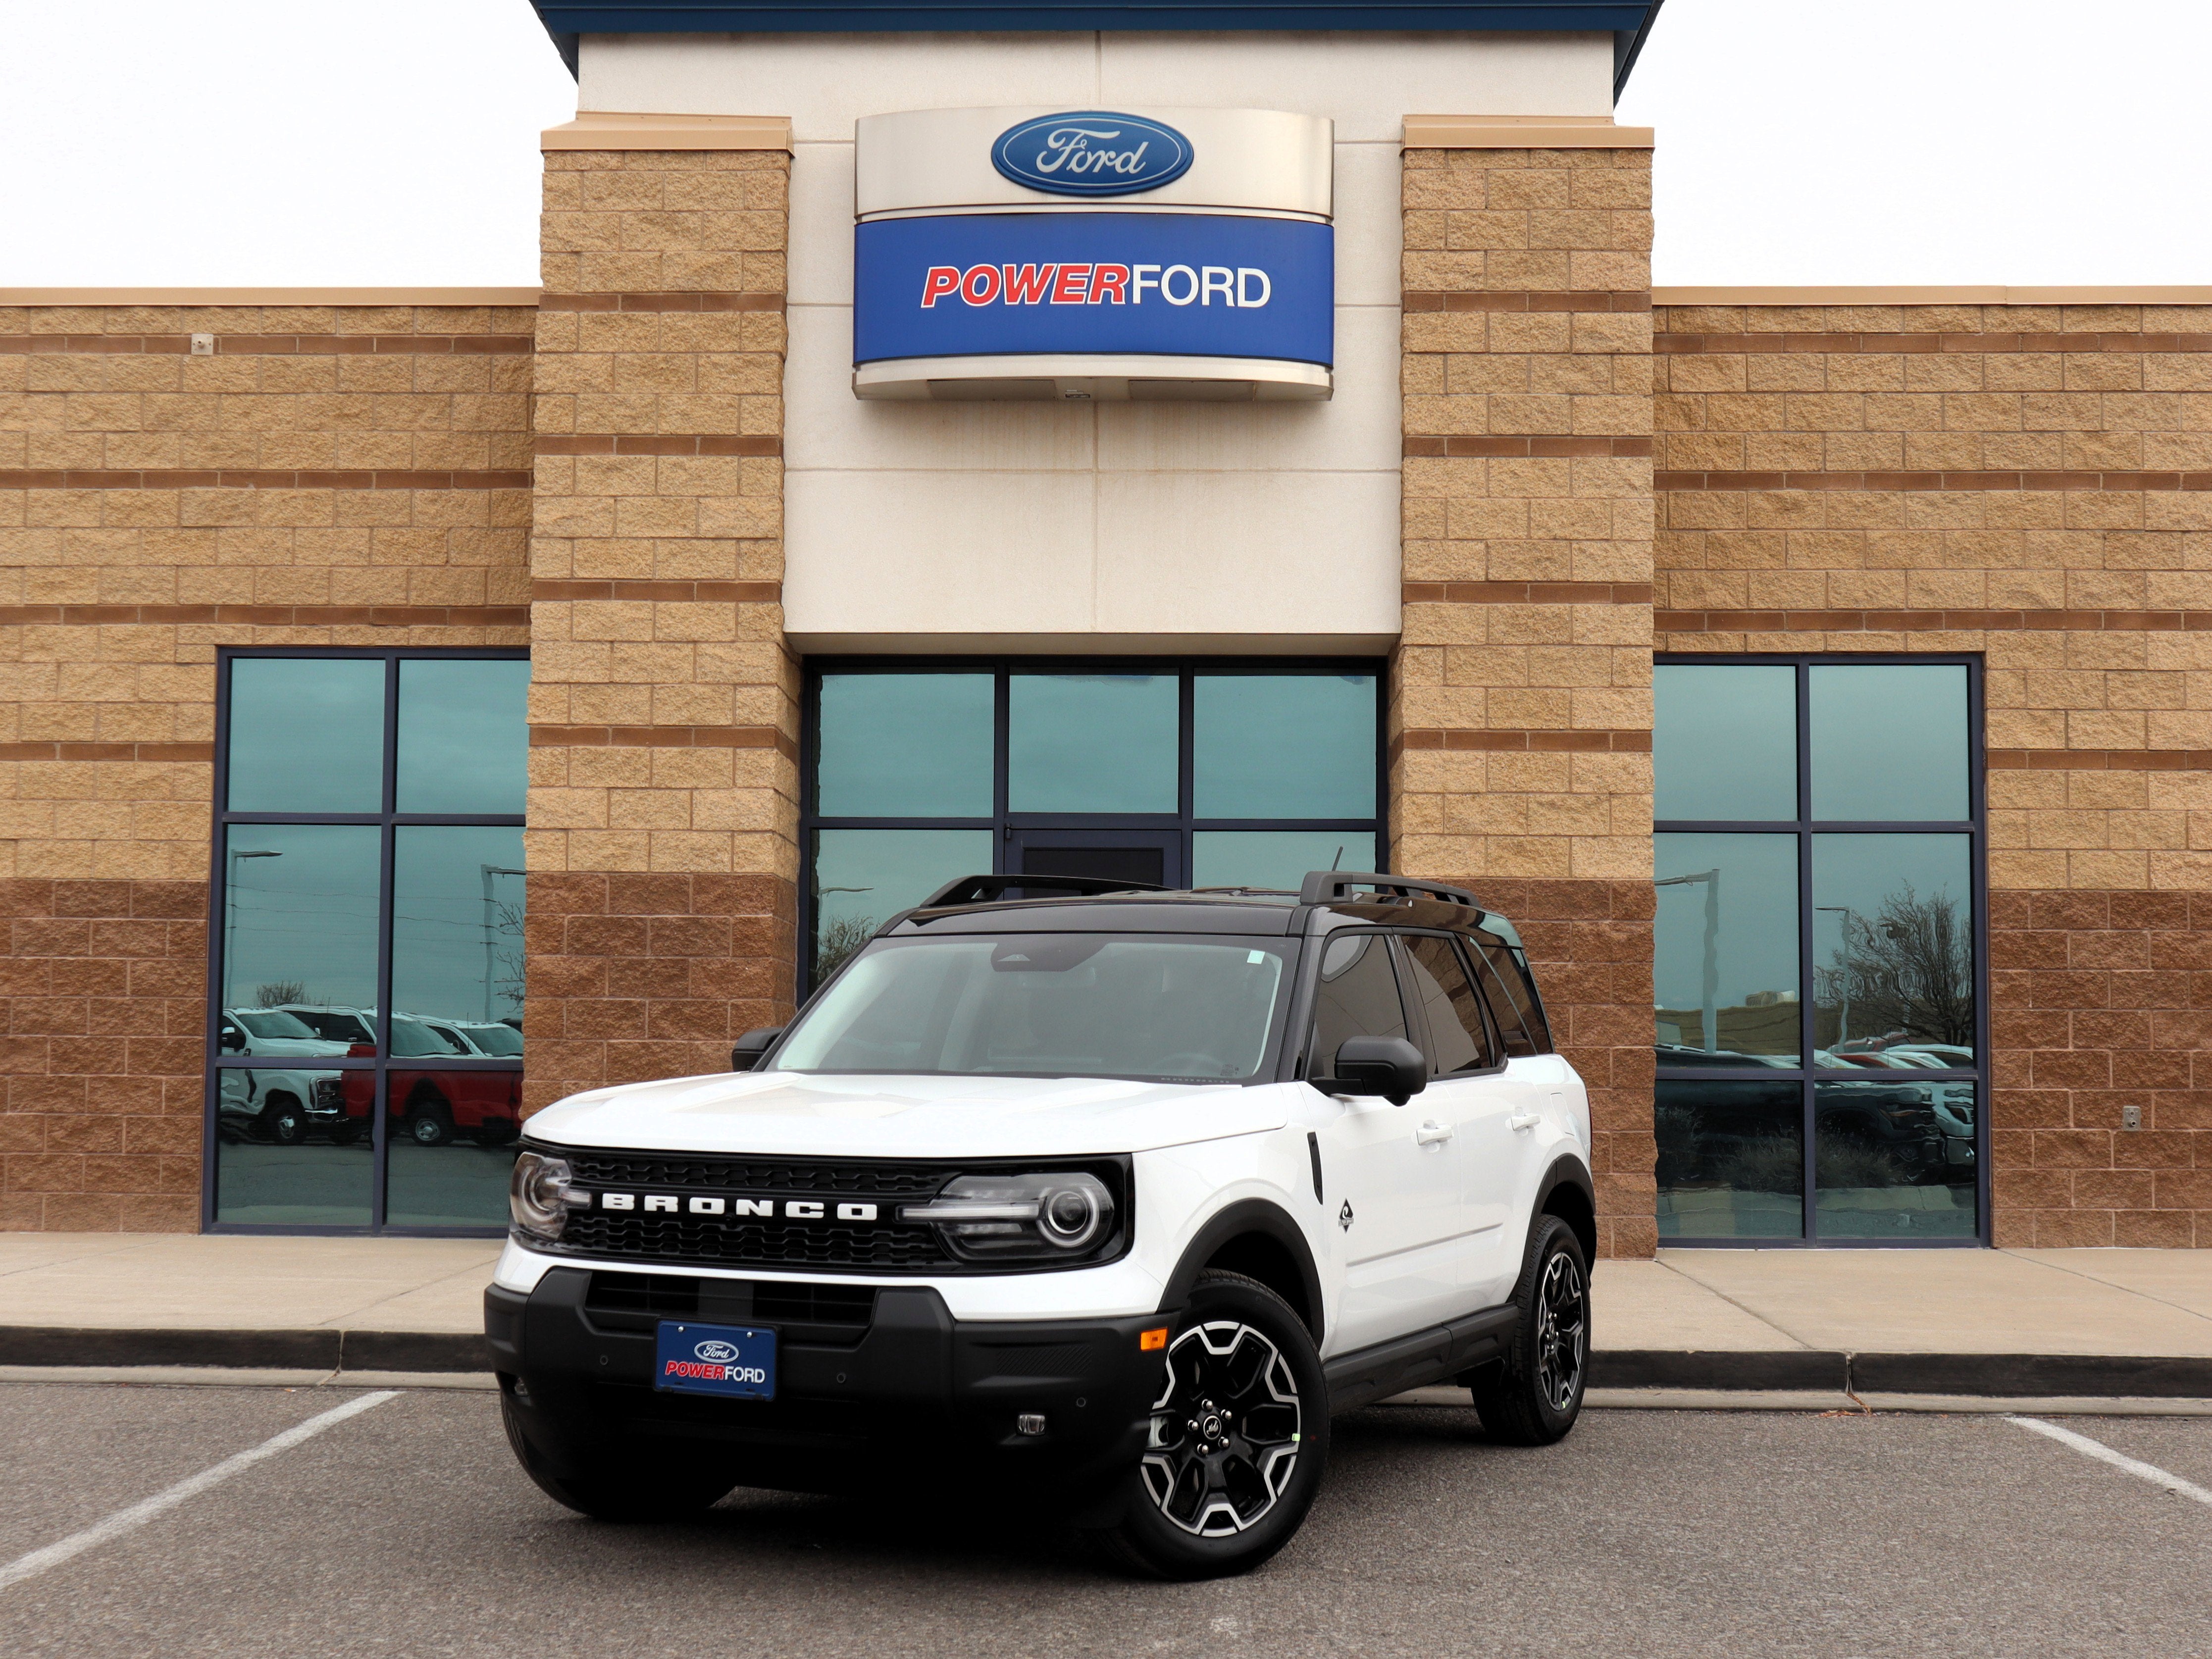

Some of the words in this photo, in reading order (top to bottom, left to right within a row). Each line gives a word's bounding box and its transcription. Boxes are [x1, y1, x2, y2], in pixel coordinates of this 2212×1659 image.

[1036, 128, 1149, 174] Ford
[602, 1193, 877, 1221] BRONCO
[703, 1344, 730, 1359] Ford
